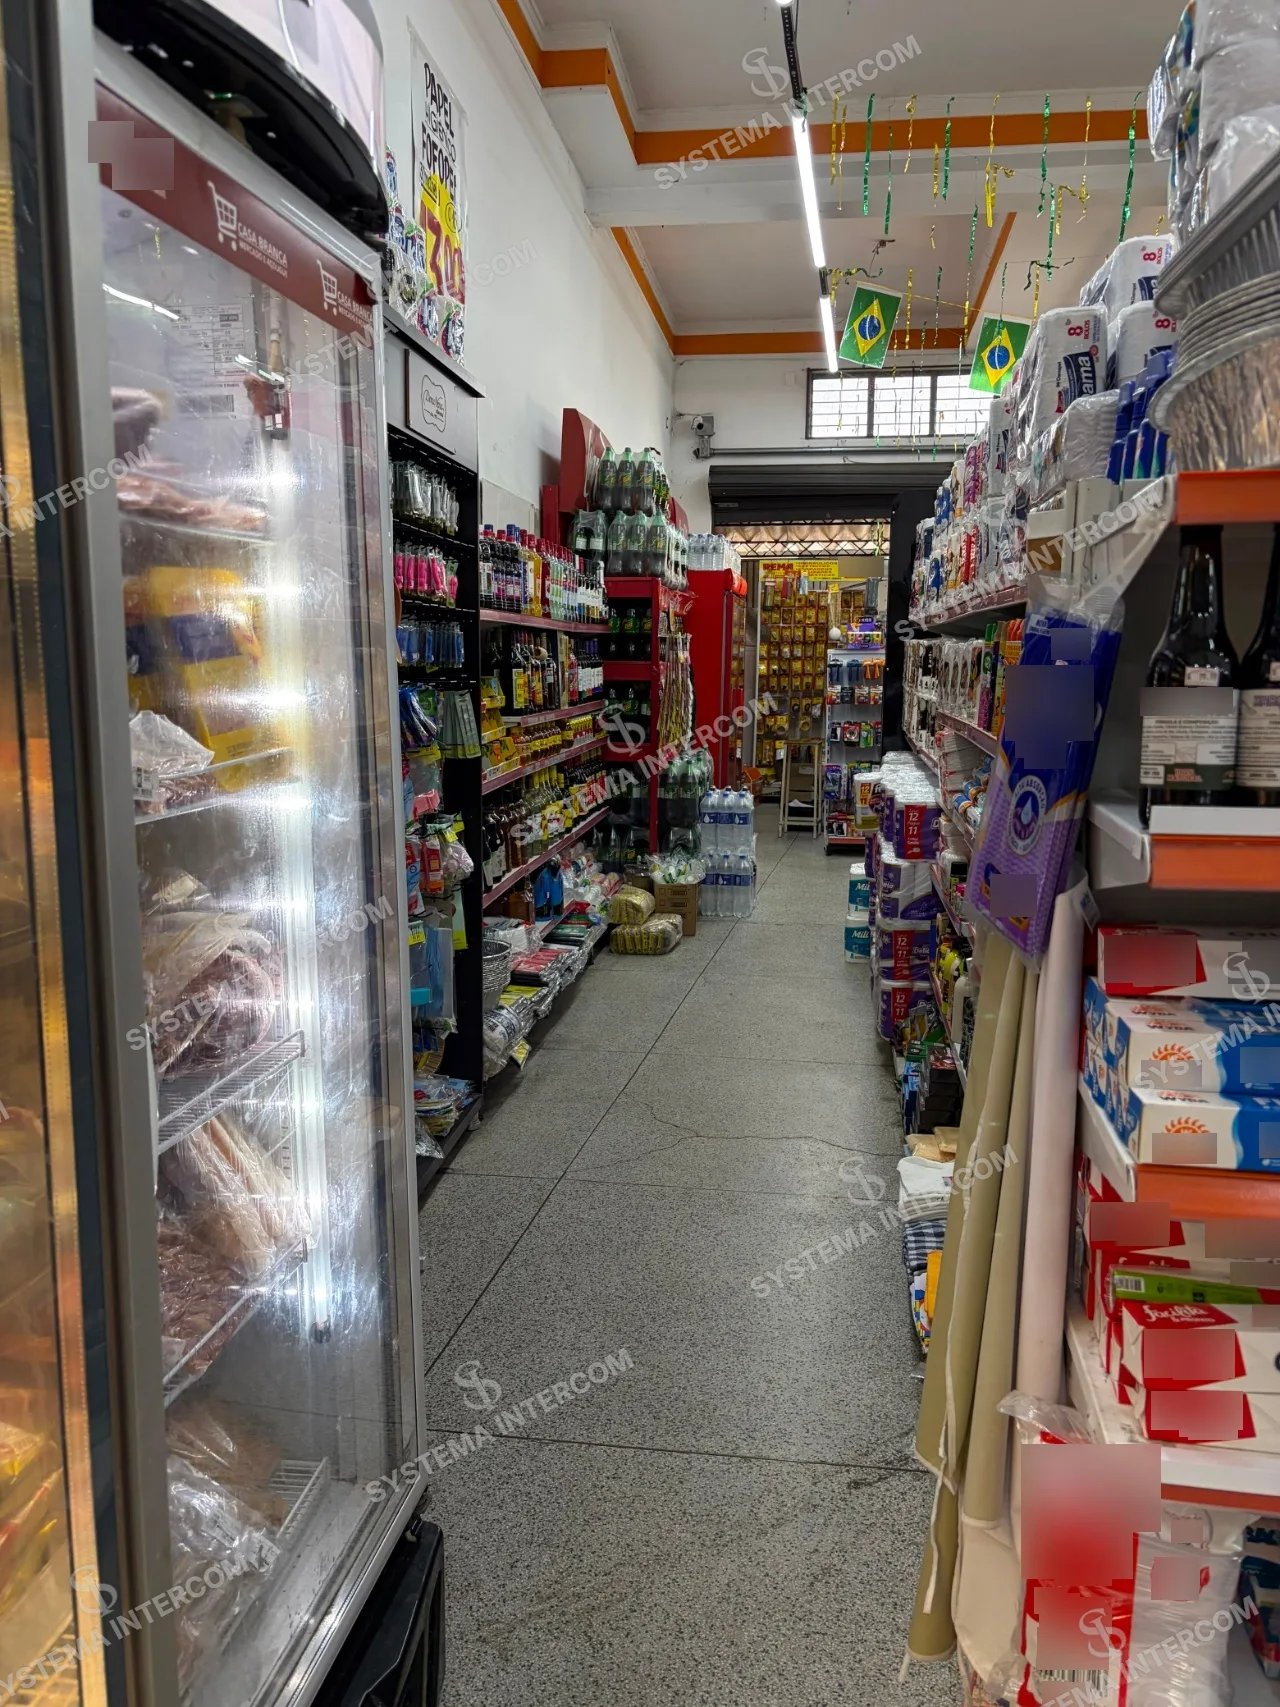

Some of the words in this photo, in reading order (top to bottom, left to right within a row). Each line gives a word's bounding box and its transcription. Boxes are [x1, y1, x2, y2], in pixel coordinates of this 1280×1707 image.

[424, 62, 455, 139] PAPEL
[238, 222, 257, 245] CASA
[258, 235, 288, 269] BRANCA
[238, 239, 263, 261] MERCADO
[1142, 252, 1157, 261] 8
[337, 291, 352, 309] CASA
[1155, 318, 1171, 329] 8
[1067, 325, 1084, 337] 8
[908, 813, 918, 821] 12
[908, 826, 918, 835] 11
[855, 882, 870, 890] Mil
[897, 937, 908, 946] 12
[897, 950, 907, 958] 11
[895, 995, 905, 1003] 12
[895, 1008, 905, 1016] 11
